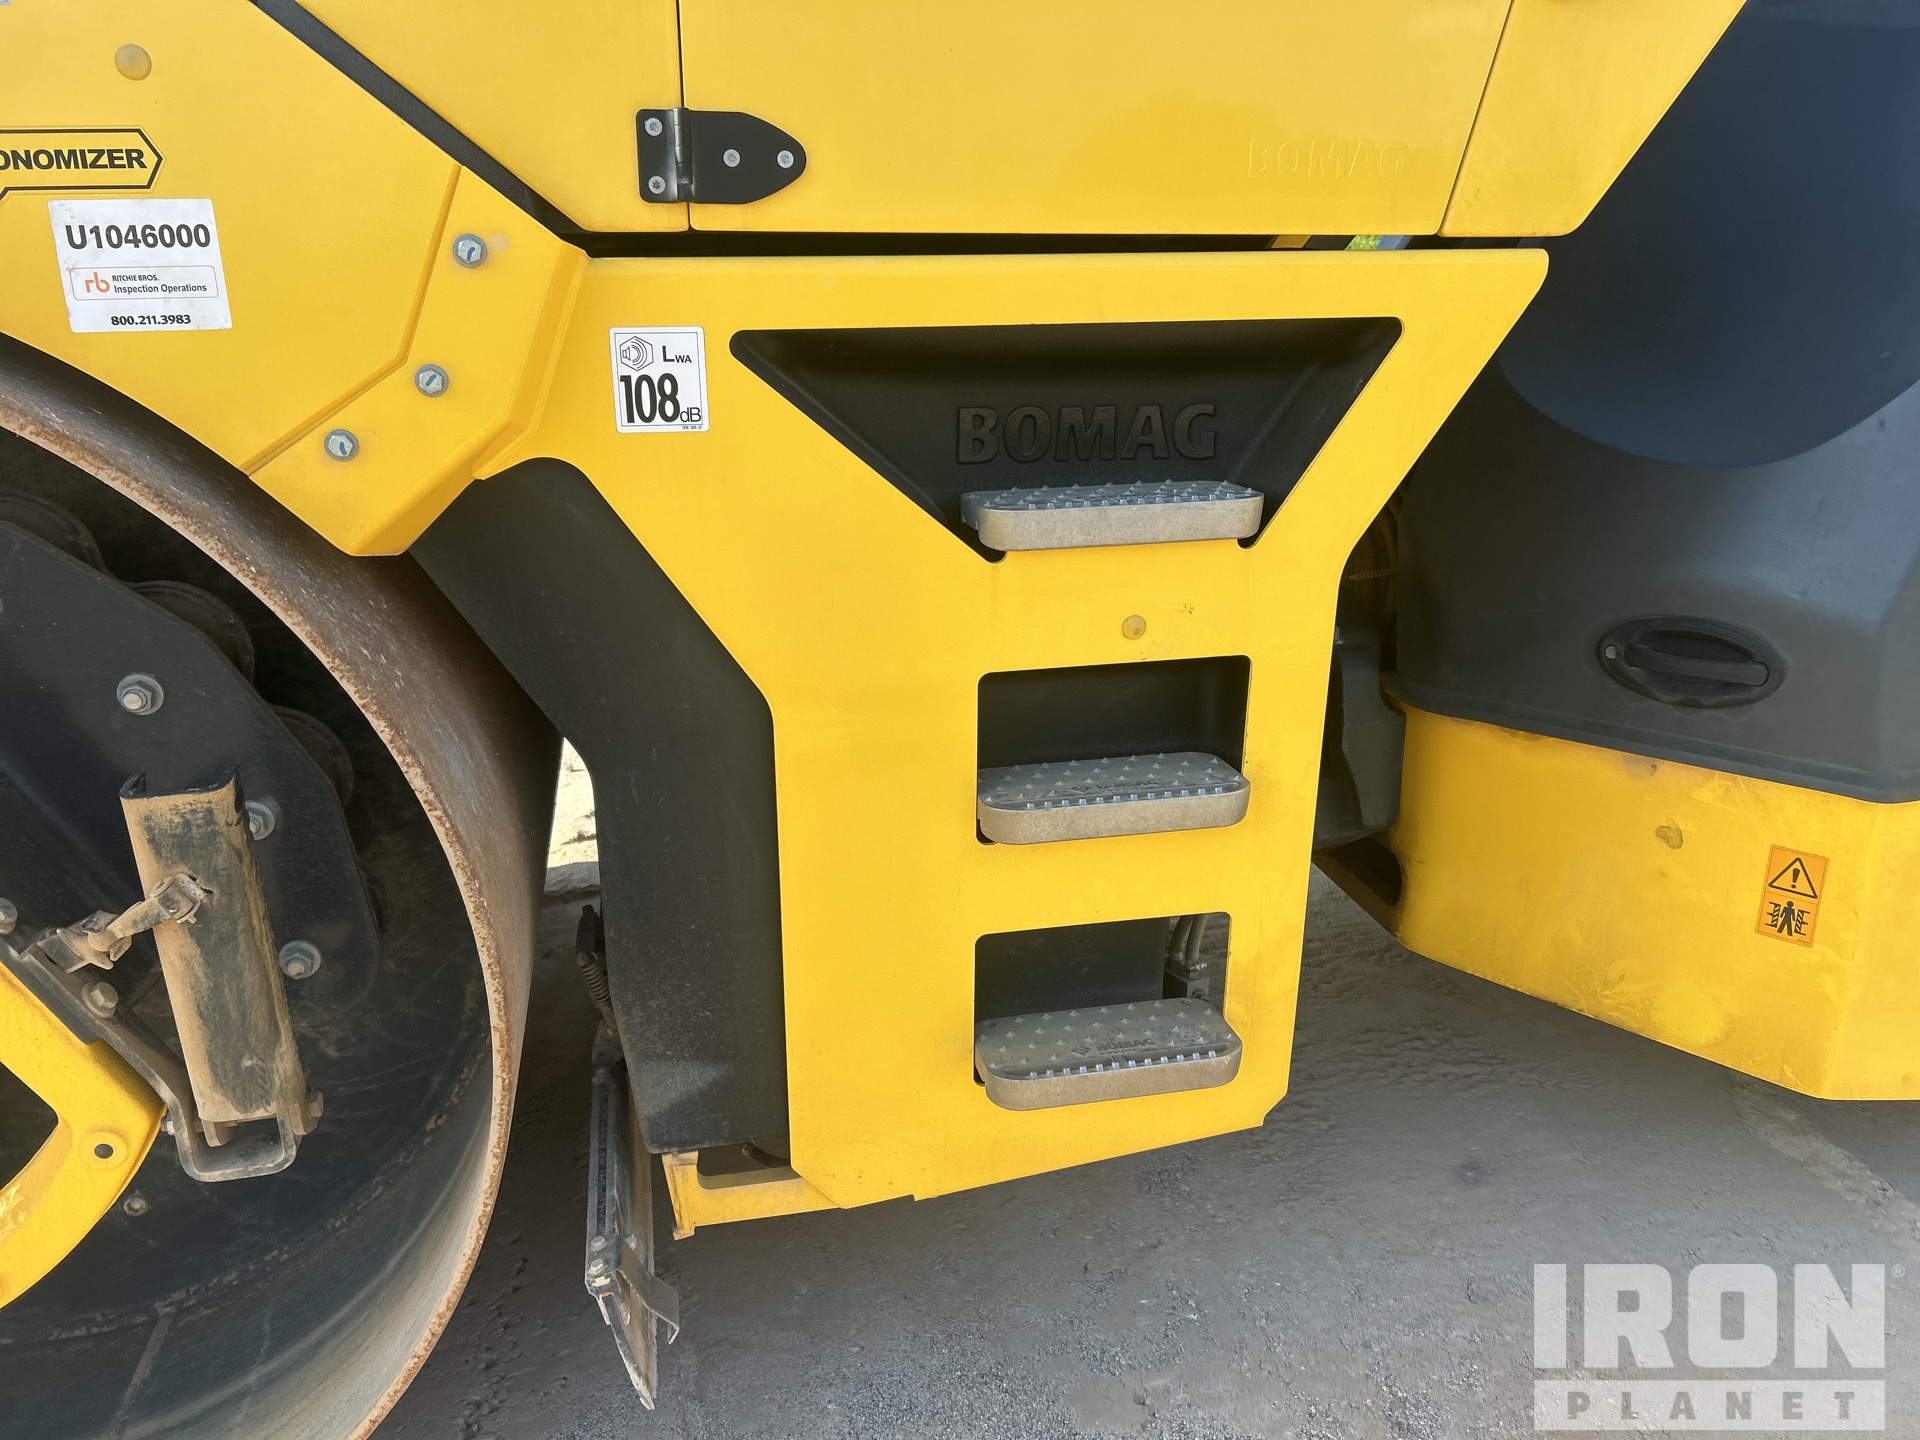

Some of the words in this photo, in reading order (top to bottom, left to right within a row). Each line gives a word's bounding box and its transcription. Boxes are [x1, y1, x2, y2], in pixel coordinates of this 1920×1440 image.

[1248, 138, 1407, 179] BOMAG
[65, 224, 211, 250] U1046000
[112, 274, 137, 282] RITCHIE
[138, 274, 160, 282] BROS.
[114, 284, 159, 295] Inspection
[160, 283, 208, 294] Operations
[110, 314, 192, 326] 800.211.3983
[957, 403, 1216, 464] BOMAG
